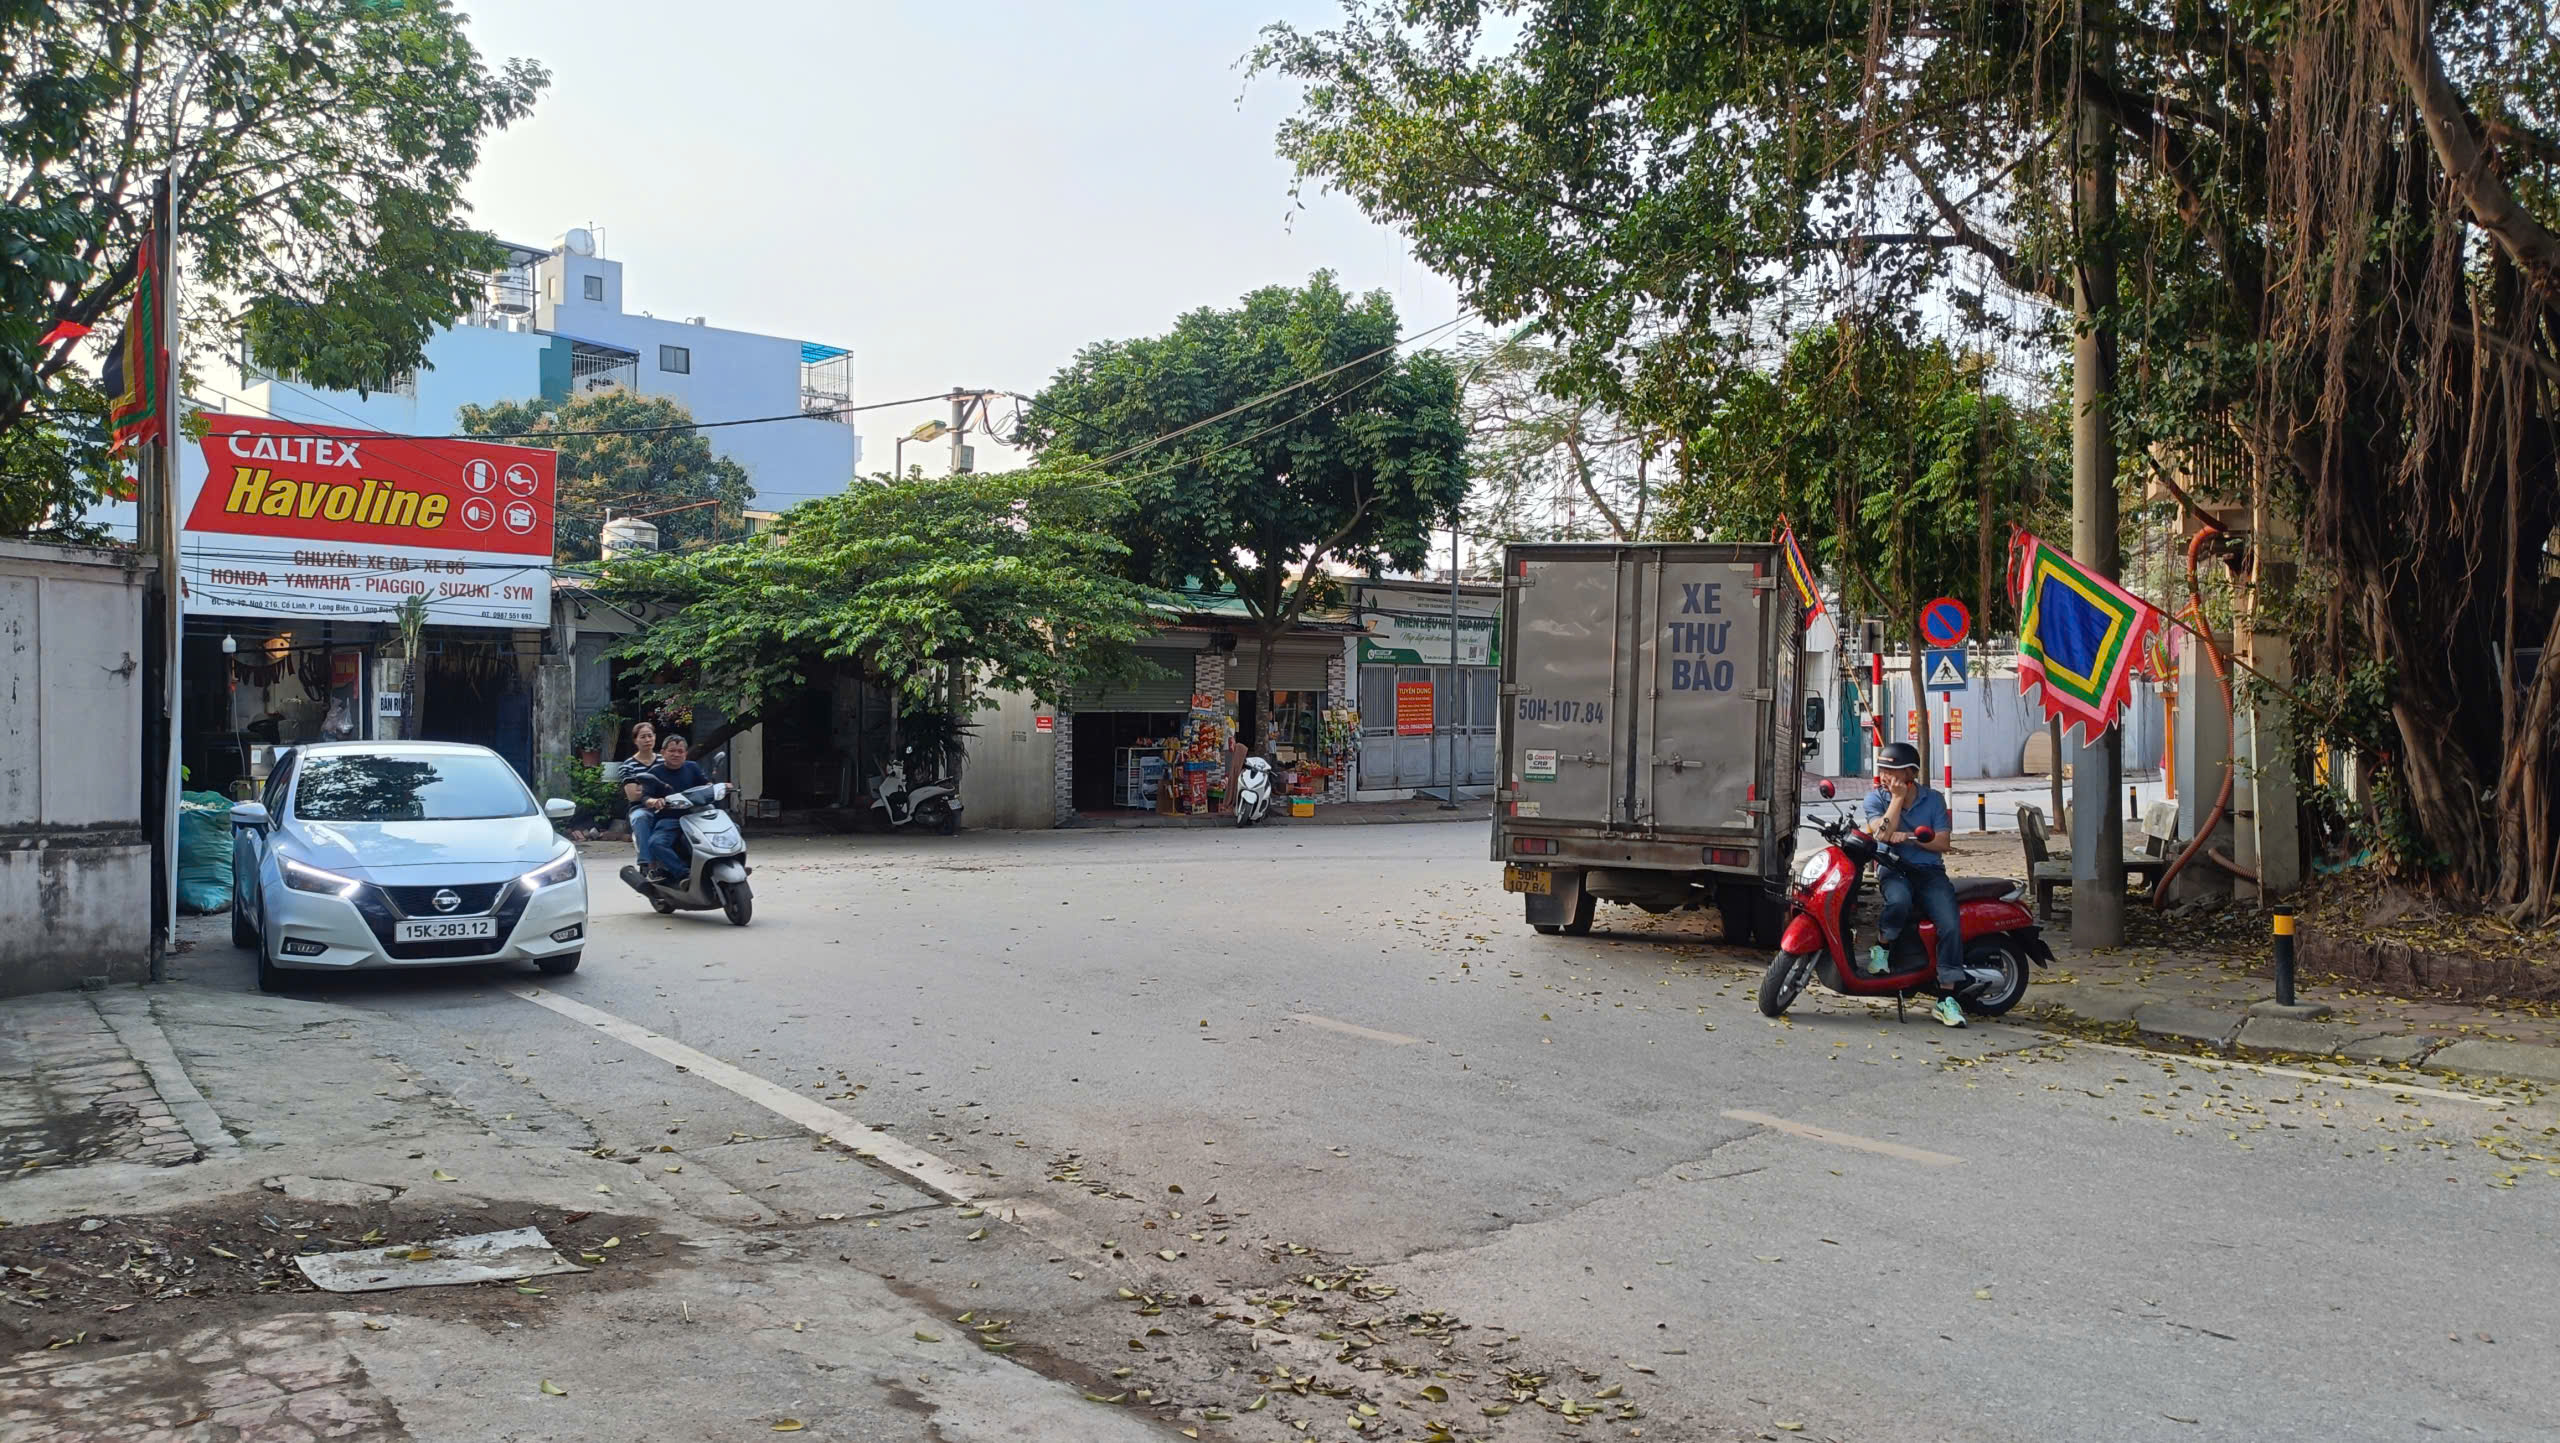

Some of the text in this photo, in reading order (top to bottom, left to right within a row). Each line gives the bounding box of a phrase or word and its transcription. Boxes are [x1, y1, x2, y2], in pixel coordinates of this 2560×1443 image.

[228, 429, 362, 469] CALTEX
[224, 465, 449, 529] Havoline
[367, 555, 385, 571] XE
[389, 557, 409, 571] GA
[424, 559, 441, 574] XE
[211, 569, 268, 586] HONDA
[284, 573, 351, 591] YAMAHA
[366, 578, 425, 595] PIAGGIO
[439, 582, 490, 598] SUZUKI
[503, 586, 533, 600] SYM
[318, 603, 334, 611] Long
[1682, 583, 1721, 614] XE
[1668, 620, 1732, 655] THƯ
[1671, 655, 1734, 692] BÁO
[381, 693, 392, 711] BÁN
[1519, 698, 1604, 724] 50H-107.84
[1511, 880, 1545, 892] 107.84
[1518, 871, 1538, 881] 50H
[406, 922, 488, 938] 15K-283.12
